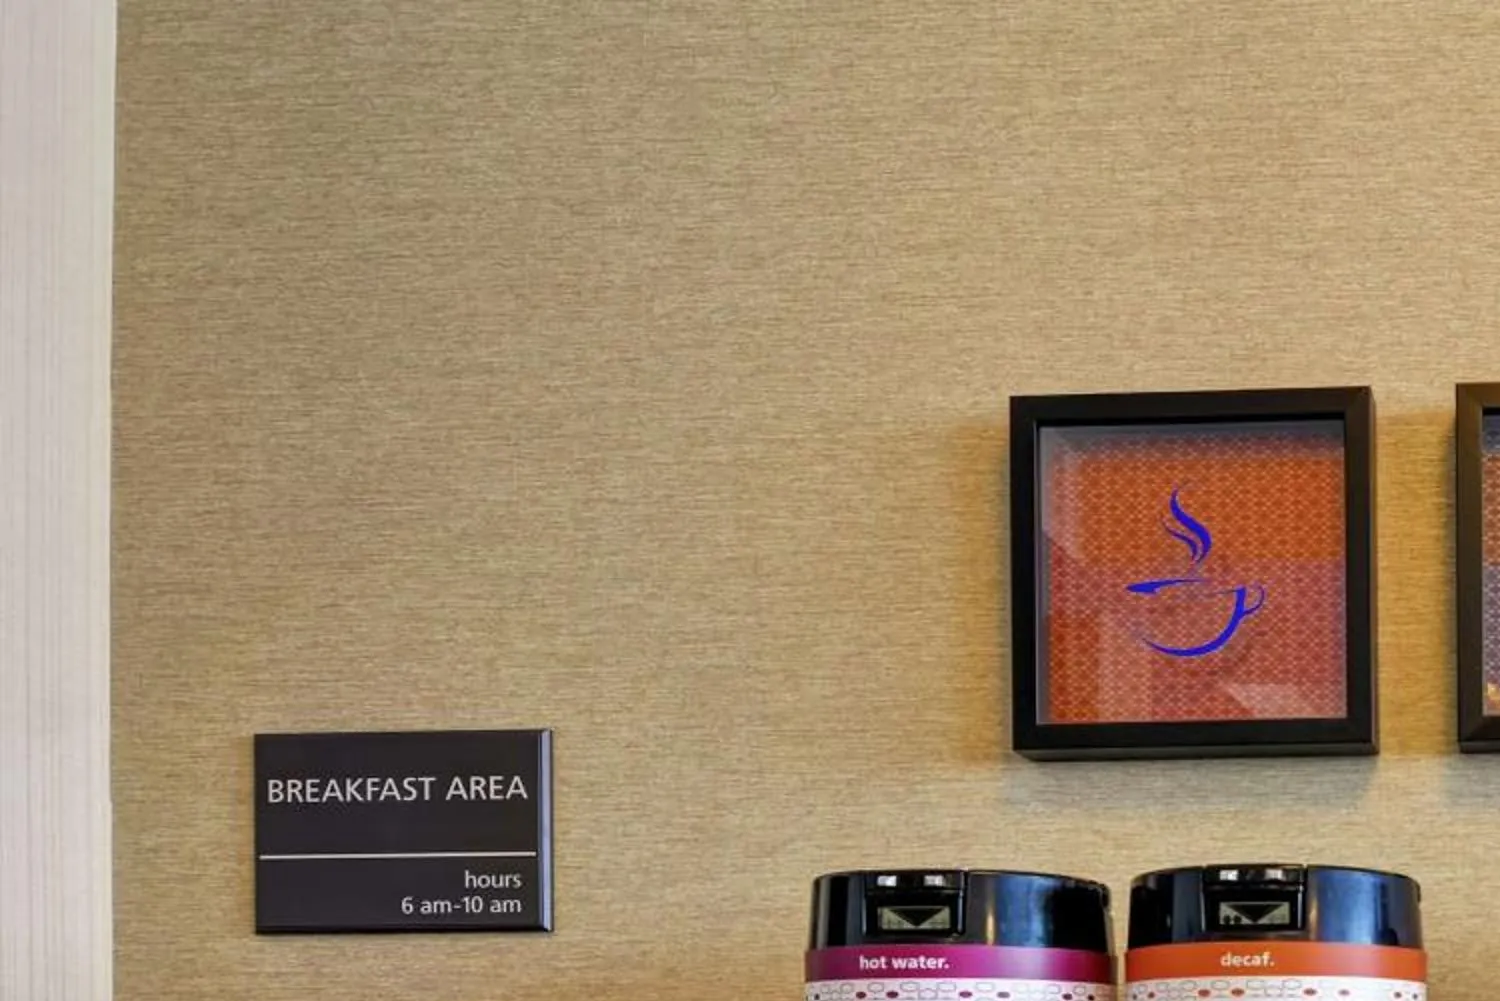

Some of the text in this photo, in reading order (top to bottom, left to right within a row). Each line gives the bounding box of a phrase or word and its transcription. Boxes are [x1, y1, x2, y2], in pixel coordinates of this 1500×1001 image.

[267, 775, 528, 803] BREAKFAST AREA
[464, 870, 522, 889] hours
[401, 896, 522, 914] 6 am-10 am
[860, 955, 950, 970] hot water.
[1220, 952, 1275, 968] decaf.
